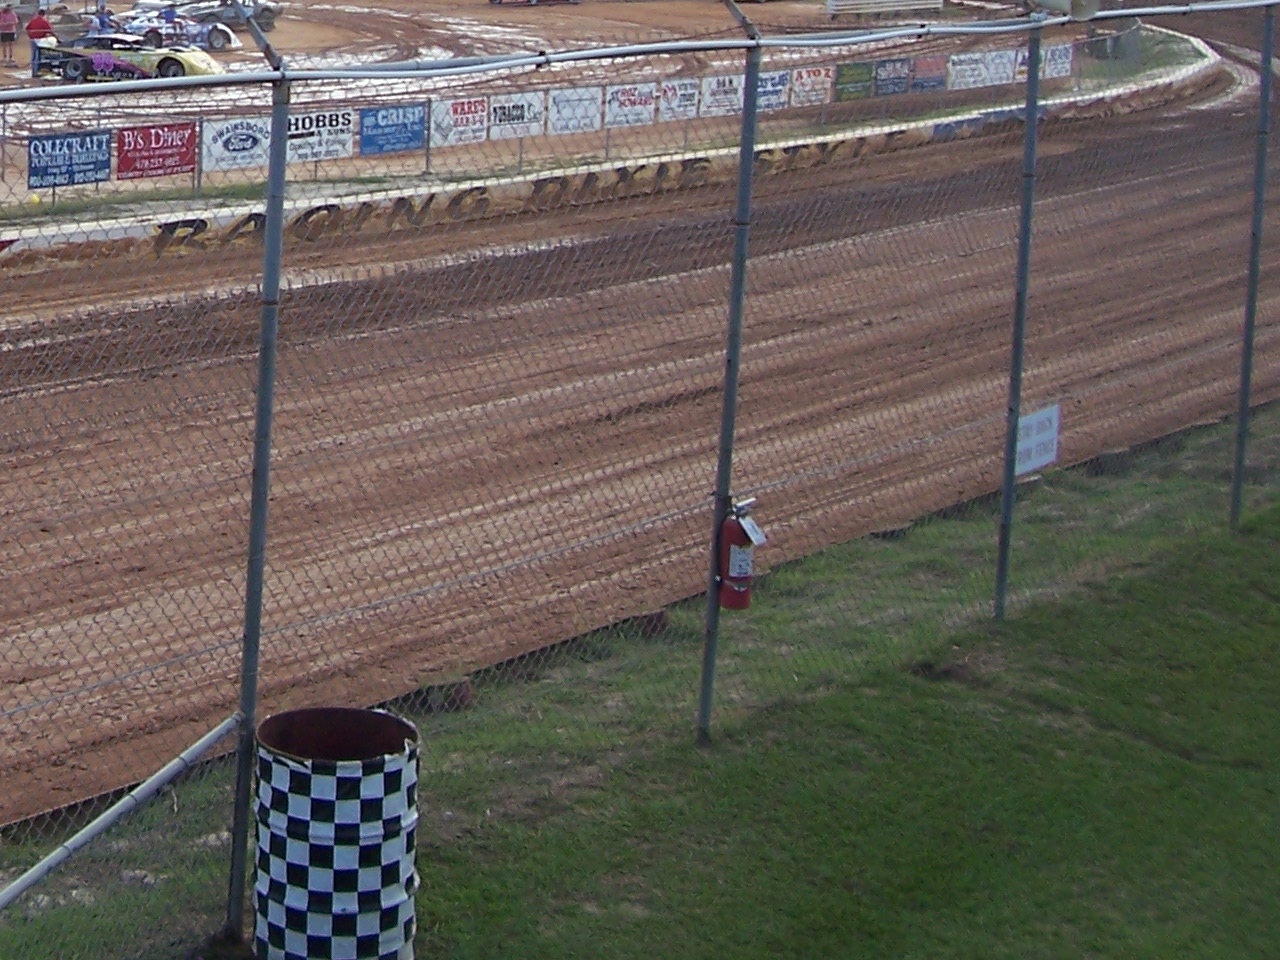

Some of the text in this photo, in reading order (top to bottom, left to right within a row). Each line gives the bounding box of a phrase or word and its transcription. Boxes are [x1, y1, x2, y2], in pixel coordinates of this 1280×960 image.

[287, 112, 352, 132] HOBBS
[377, 106, 424, 127] CRISP
[122, 127, 192, 150] B's Diner
[211, 121, 270, 145] SWAINSBORO
[228, 135, 254, 150] Ford
[30, 134, 110, 156] COLECRAFT
